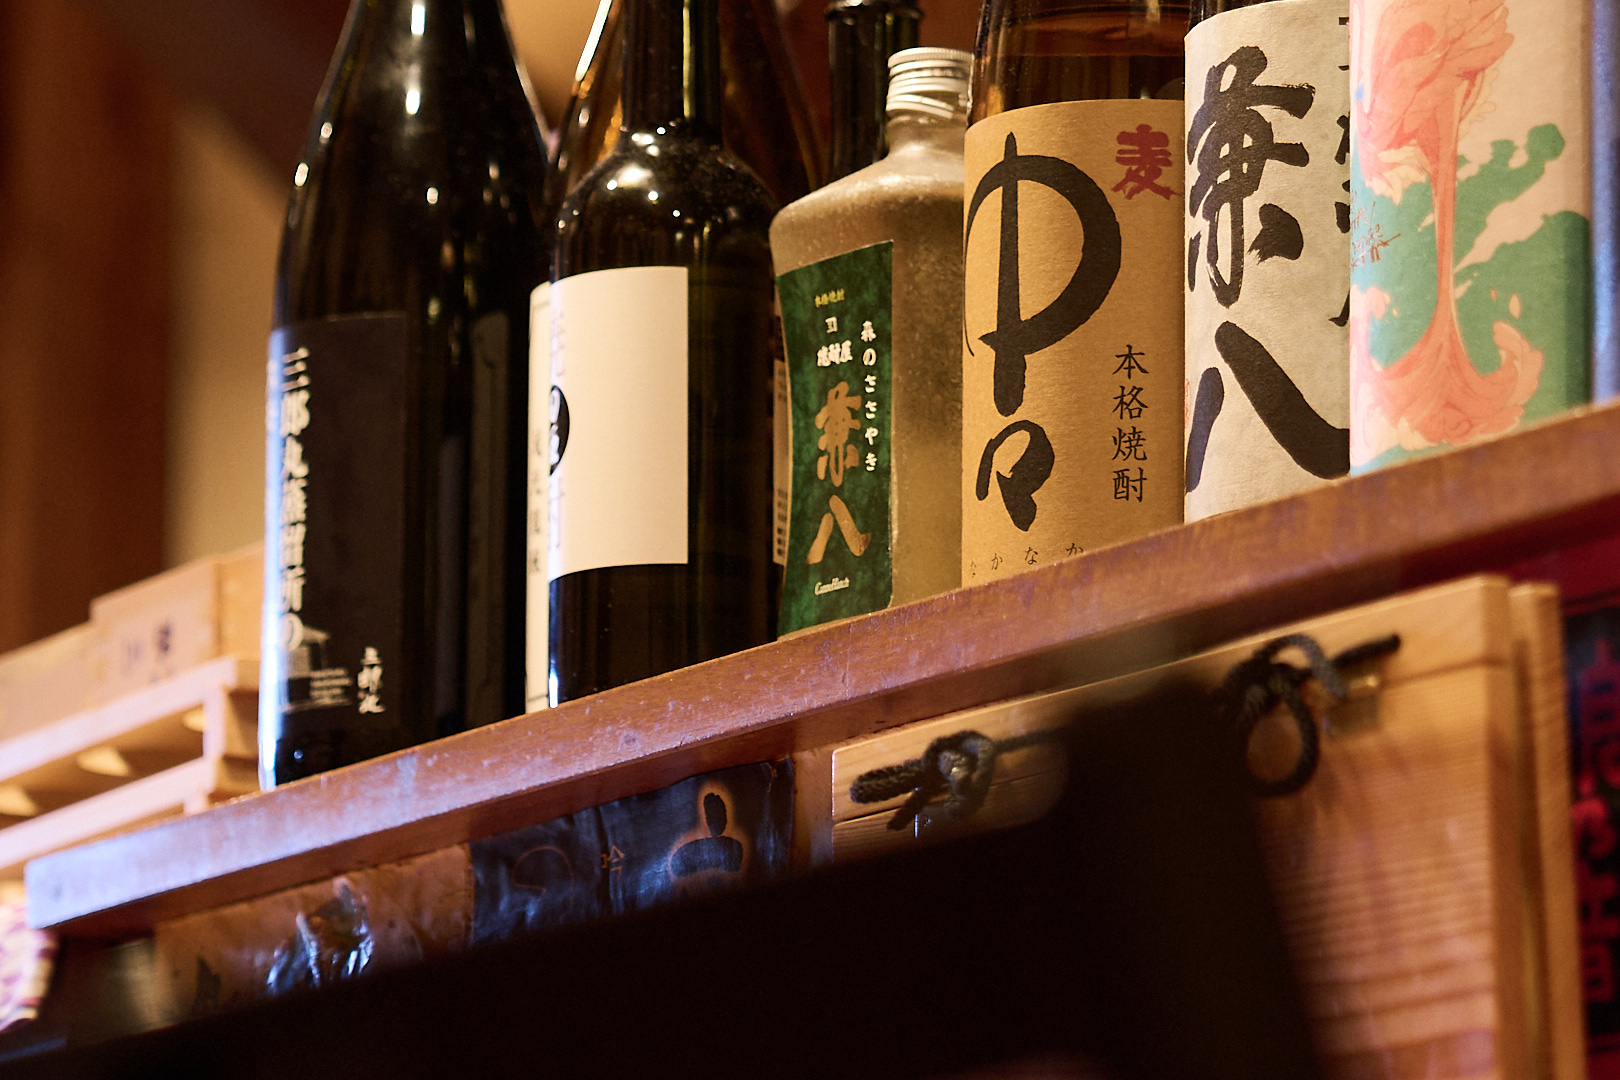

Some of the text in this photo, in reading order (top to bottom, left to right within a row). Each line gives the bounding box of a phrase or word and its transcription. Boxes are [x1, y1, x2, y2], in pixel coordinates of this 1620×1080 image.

[1111, 124, 1182, 200] 麦
[1186, 45, 1350, 492] 兼八
[805, 381, 871, 564] 兼八
[1111, 344, 1149, 502] 本格焼酎
